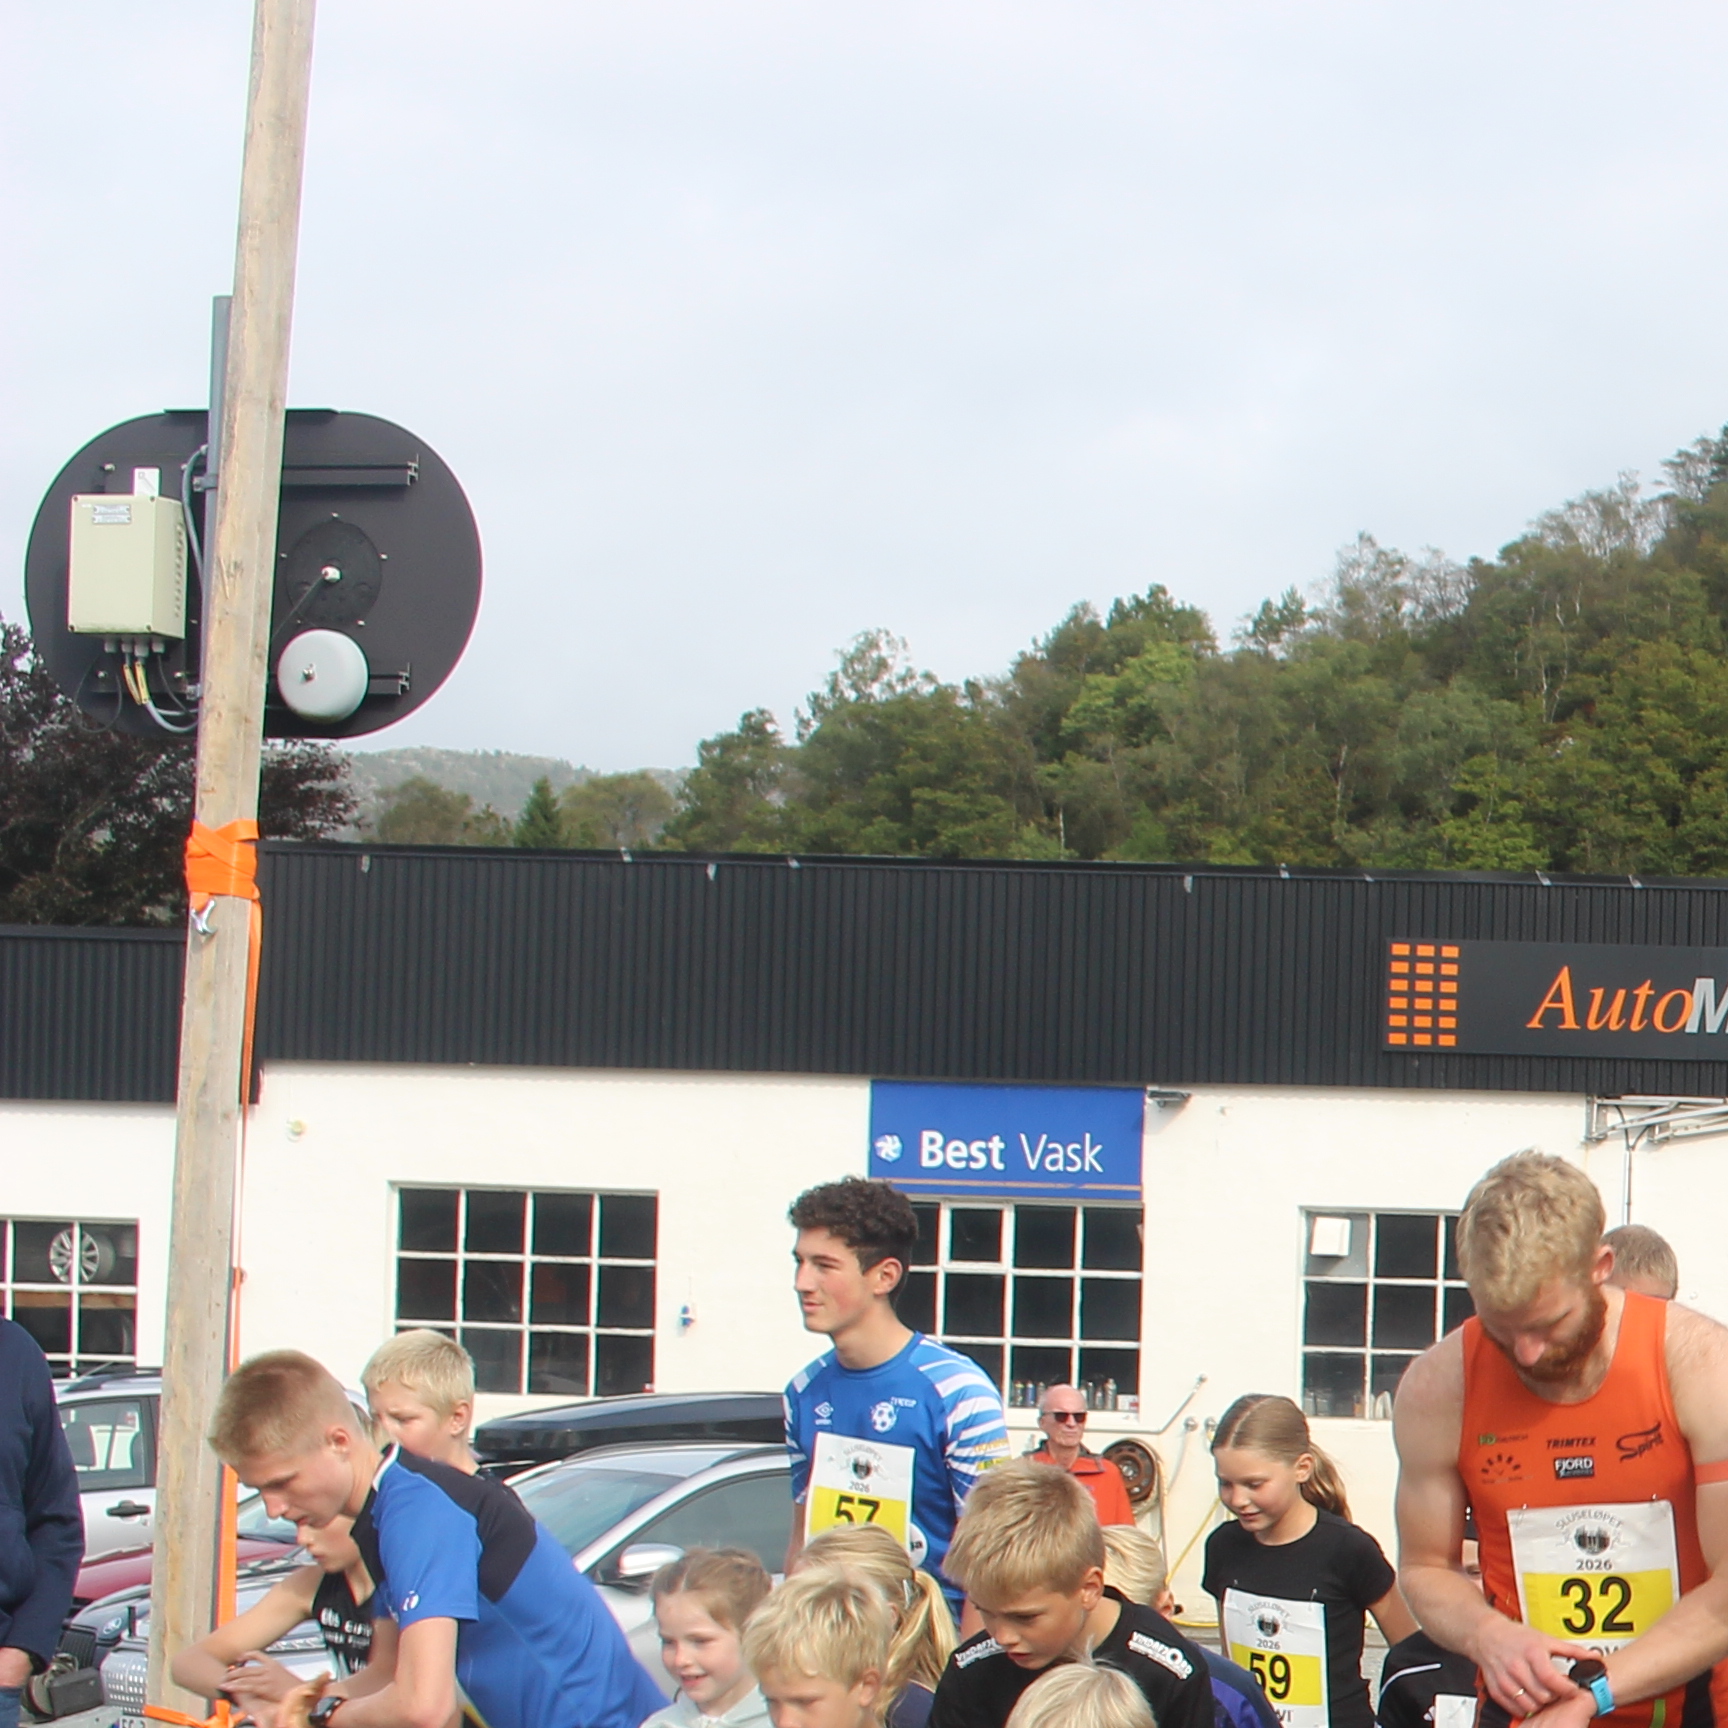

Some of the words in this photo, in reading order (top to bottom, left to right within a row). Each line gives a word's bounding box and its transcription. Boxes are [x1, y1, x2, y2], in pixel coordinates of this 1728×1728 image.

[920, 1129, 1006, 1171] Best
[1020, 1131, 1104, 1174] Vask
[1545, 1436, 1597, 1451] TRIMTEX
[1554, 1457, 1594, 1471] FJORD
[848, 1480, 871, 1493] 2026
[835, 1494, 881, 1524] 57
[1553, 1508, 1625, 1530] SLUSELØPET
[1575, 1558, 1613, 1571] 2026
[1559, 1576, 1635, 1635] 32
[1256, 1638, 1281, 1650] 2026
[1249, 1653, 1292, 1700] 59
